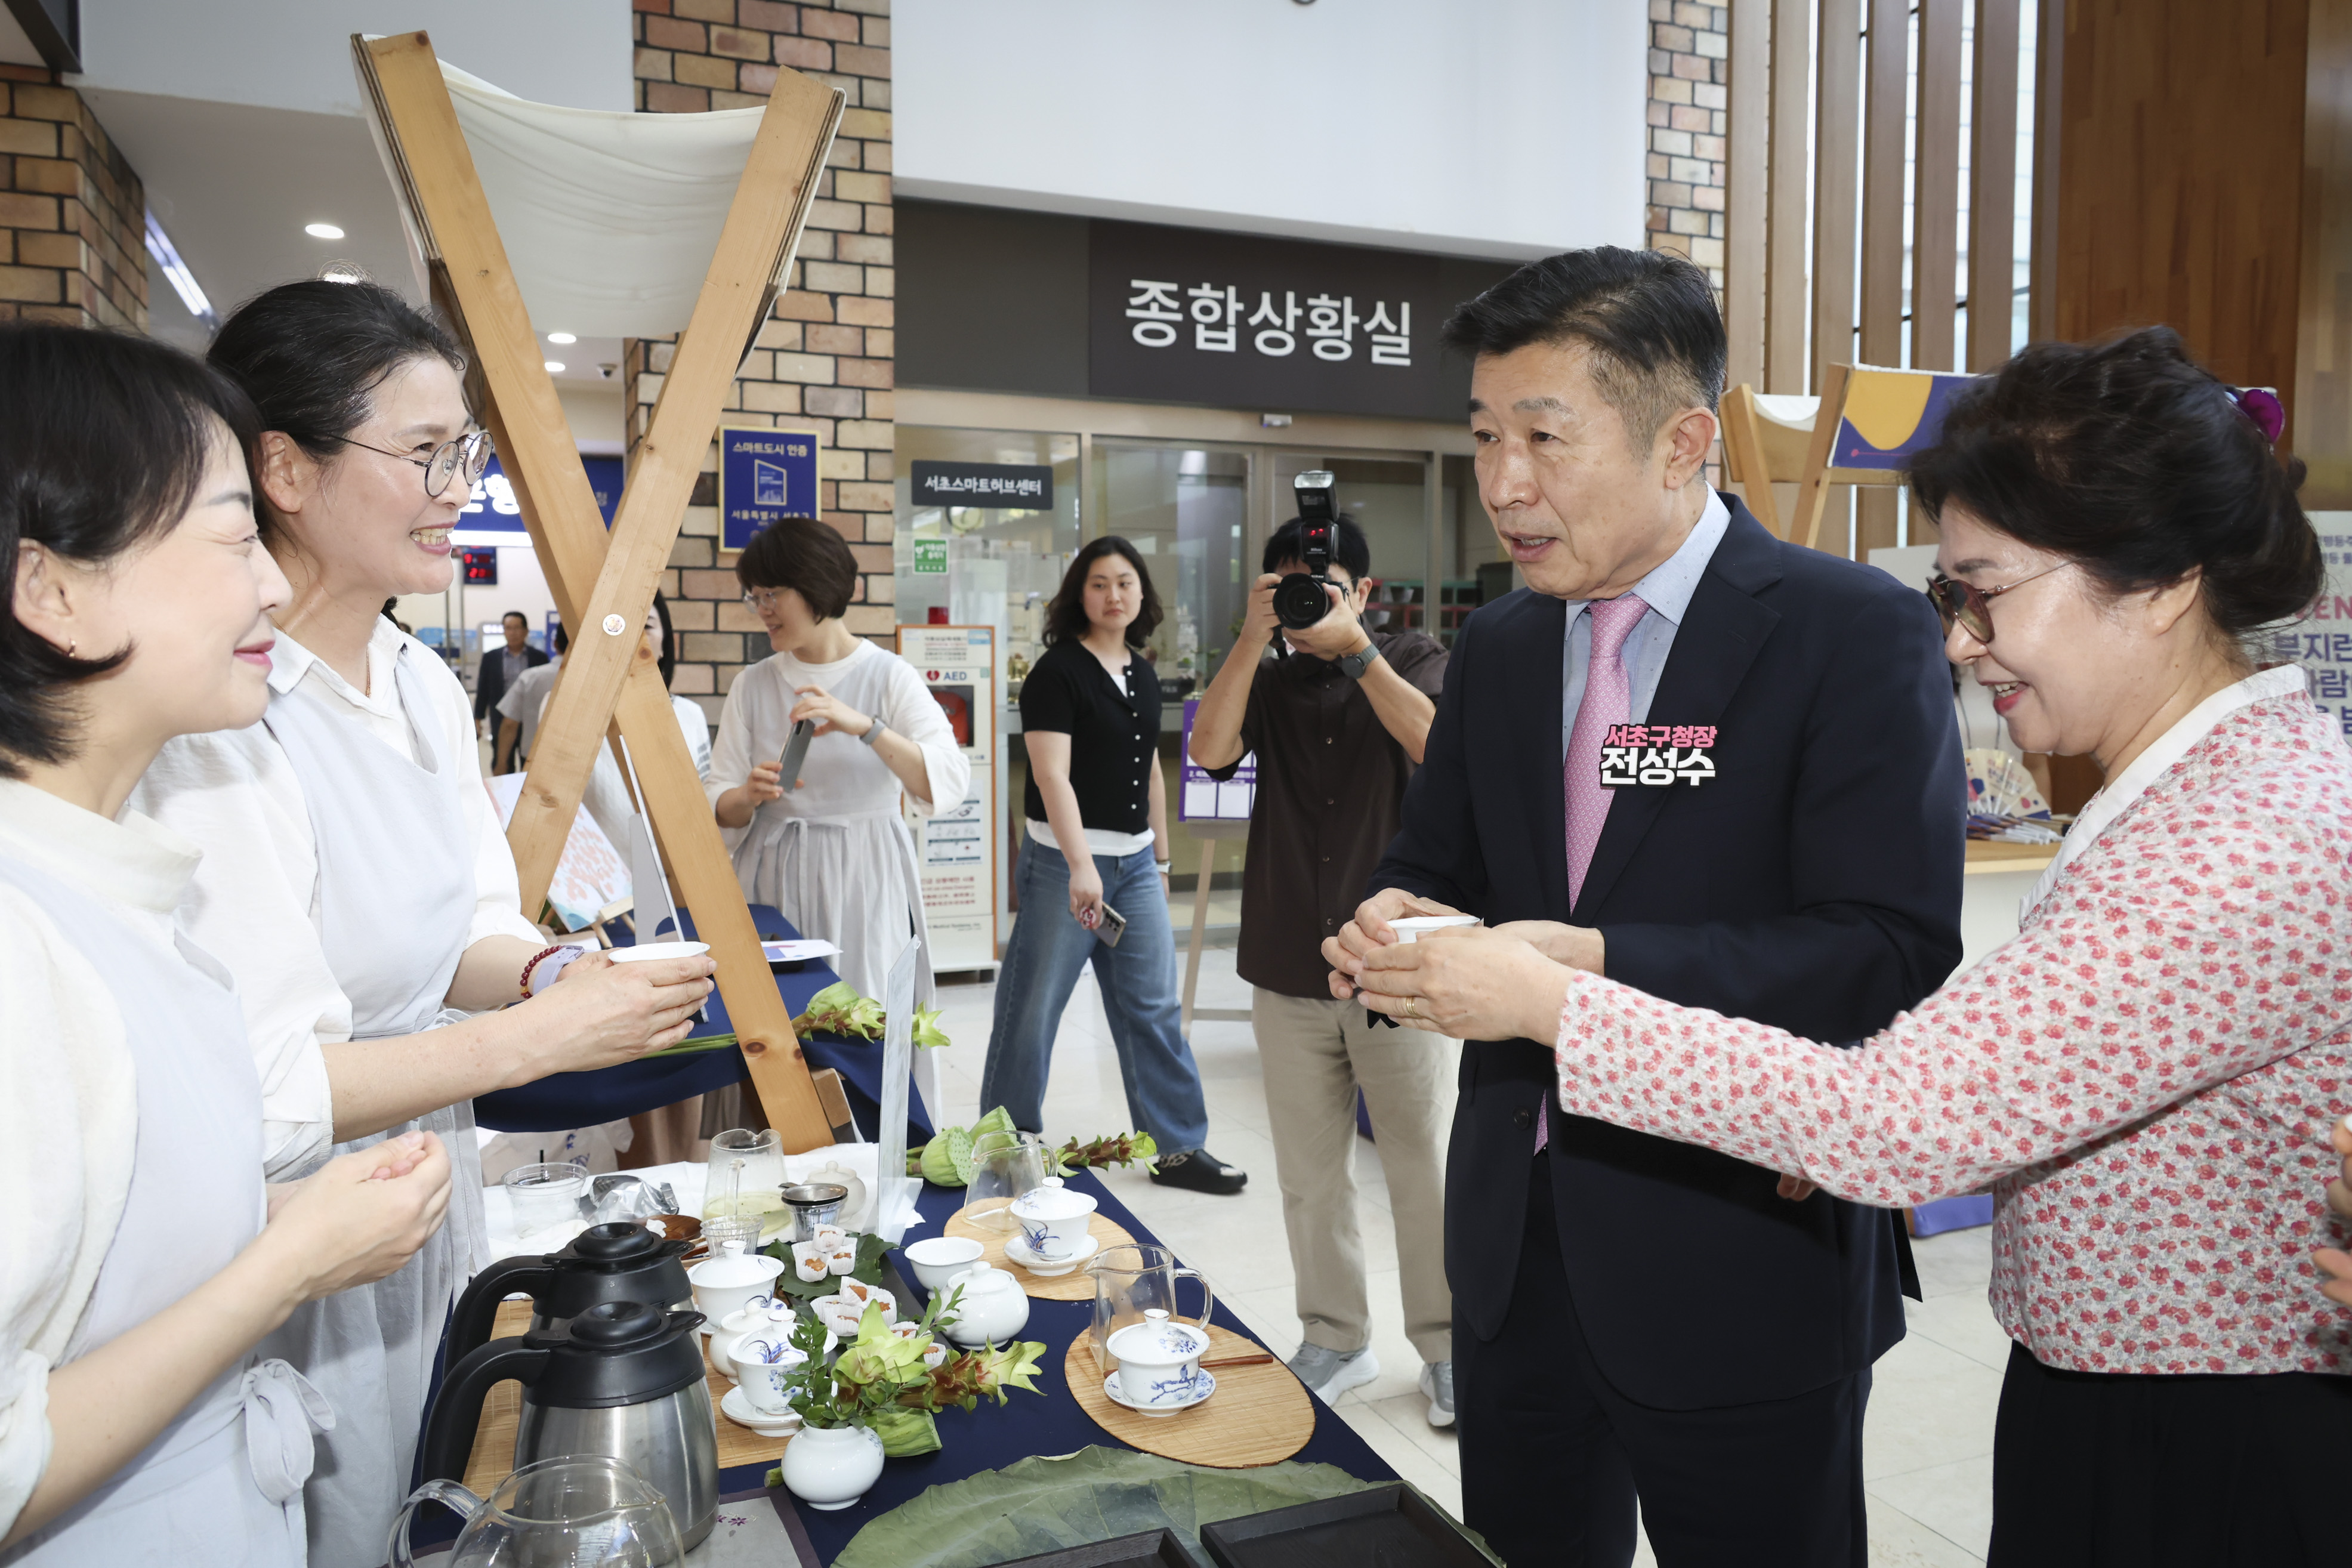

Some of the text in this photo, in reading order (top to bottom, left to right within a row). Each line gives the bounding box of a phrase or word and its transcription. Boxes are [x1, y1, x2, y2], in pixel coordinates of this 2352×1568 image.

[1125, 279, 1412, 366] 종합상황실
[732, 442, 808, 458] 스마트도시 인증
[924, 475, 1042, 496] 서초스마트허브센터
[943, 671, 967, 681] AED
[1604, 726, 1718, 748] 서초구청장
[1601, 747, 1716, 786] 전성수
